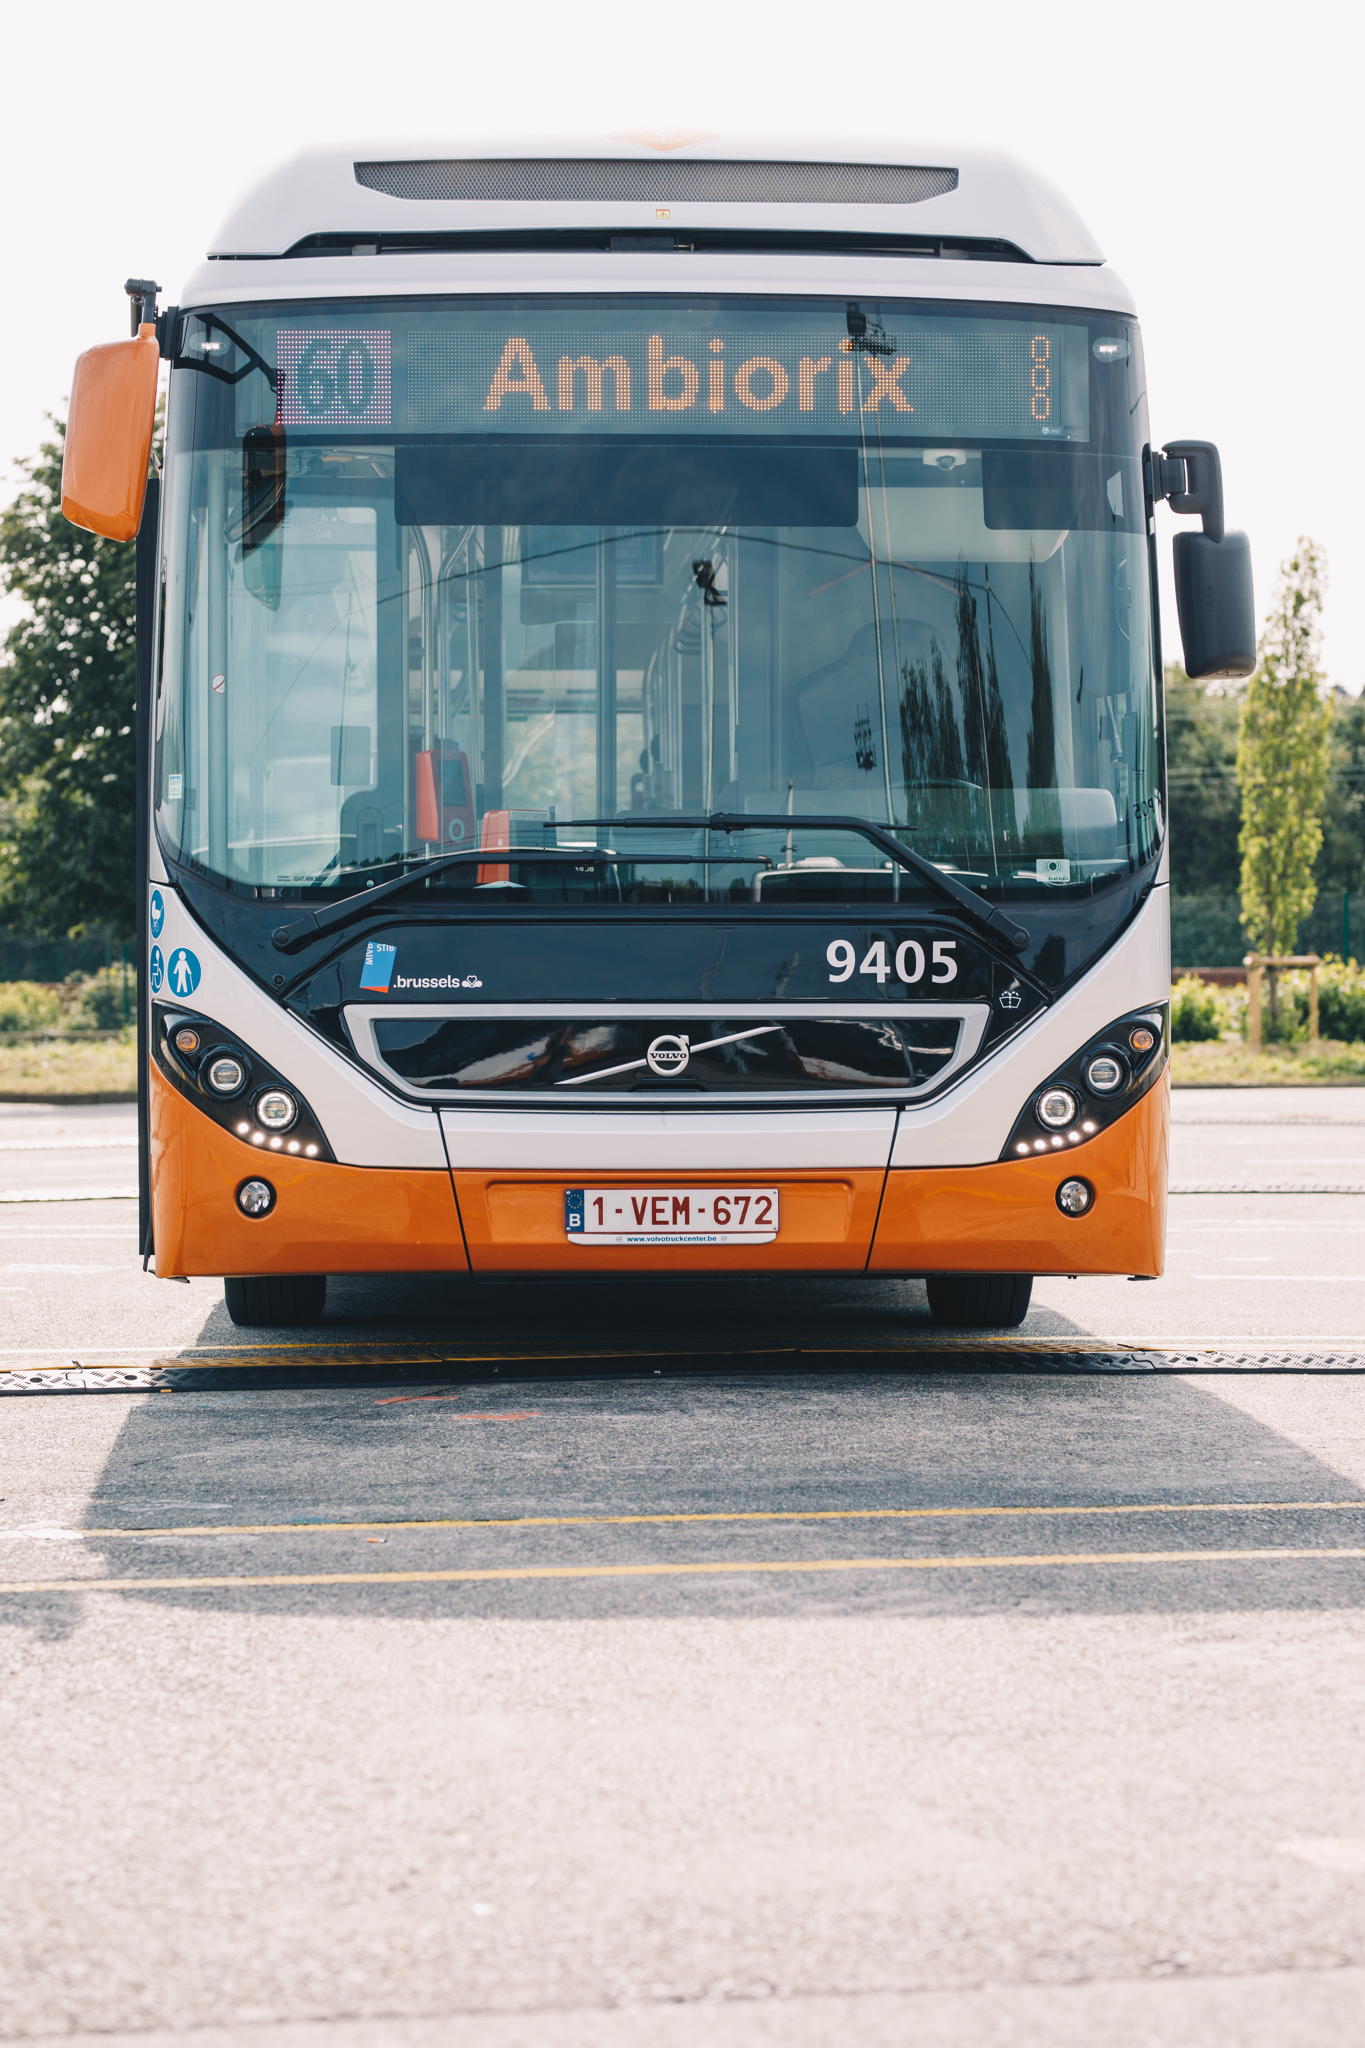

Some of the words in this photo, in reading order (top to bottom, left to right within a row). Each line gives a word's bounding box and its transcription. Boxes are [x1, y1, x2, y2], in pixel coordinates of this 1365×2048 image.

[299, 340, 374, 415] 60
[483, 335, 915, 414] Ambiorix
[826, 939, 958, 984] 9405
[393, 975, 460, 988] .brussels
[569, 1213, 581, 1227] B
[593, 1196, 773, 1225] 1-VEM-672
